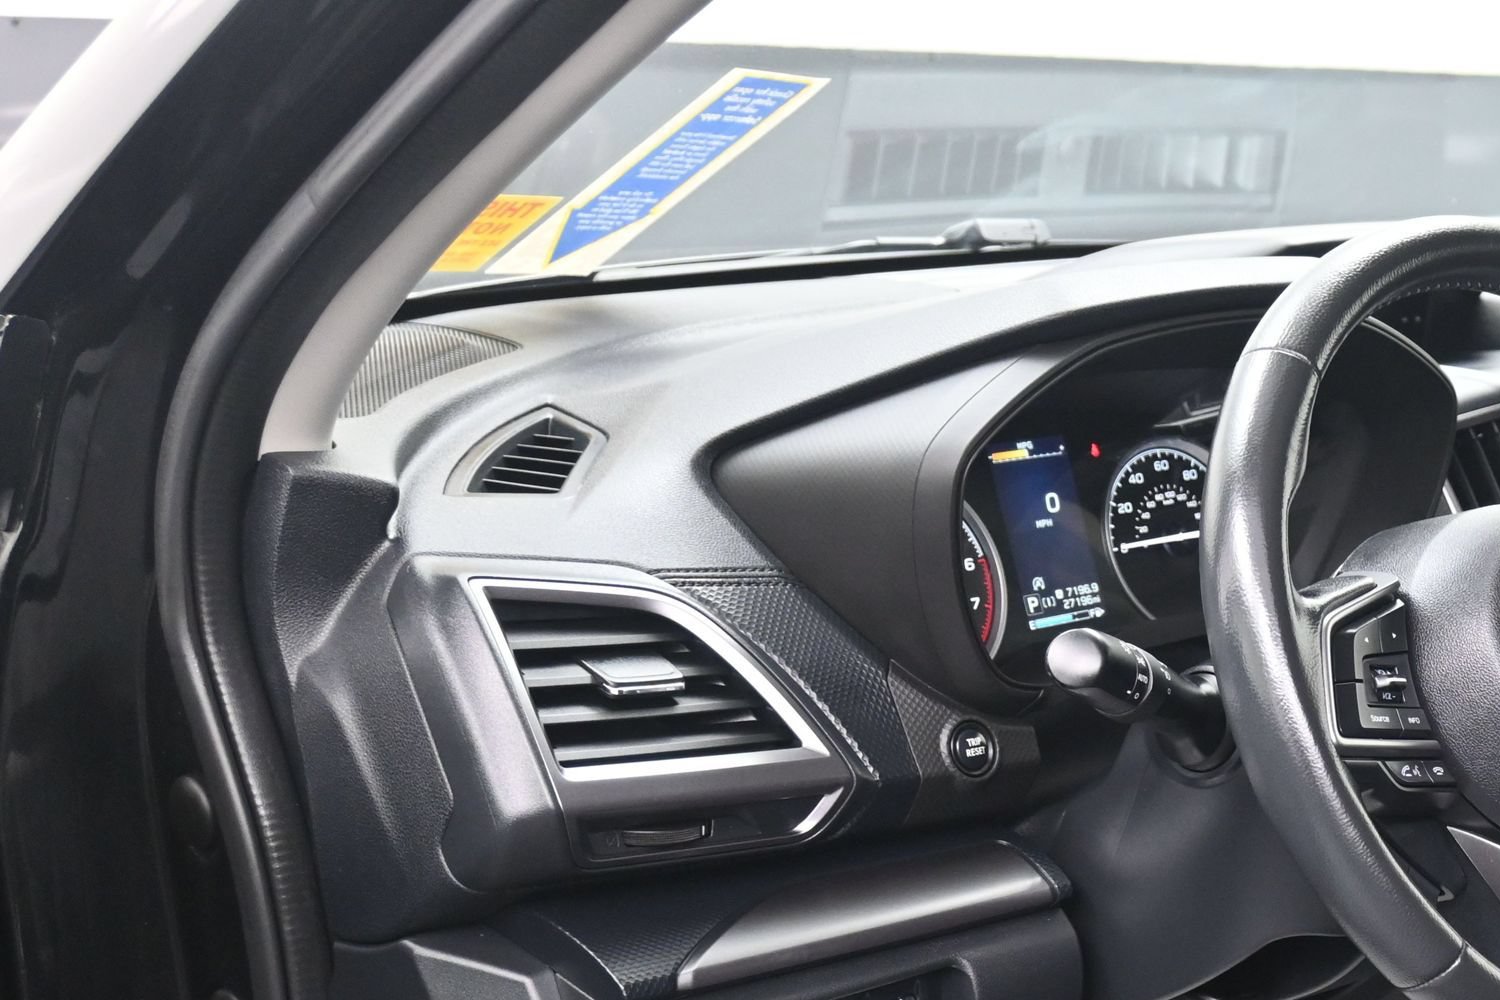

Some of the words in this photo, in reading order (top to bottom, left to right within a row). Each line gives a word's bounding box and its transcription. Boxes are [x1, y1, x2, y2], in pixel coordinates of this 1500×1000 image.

[1153, 459, 1170, 472] 60
[1128, 471, 1145, 484] 40
[1182, 468, 1198, 481] 80
[1045, 491, 1061, 514] 0
[1117, 501, 1134, 514] 20
[1035, 518, 1054, 529] MPH
[963, 557, 976, 572] 6
[970, 596, 981, 610] 7
[1027, 596, 1039, 613] P
[966, 736, 981, 747] TRIP
[965, 746, 986, 758] RESET
